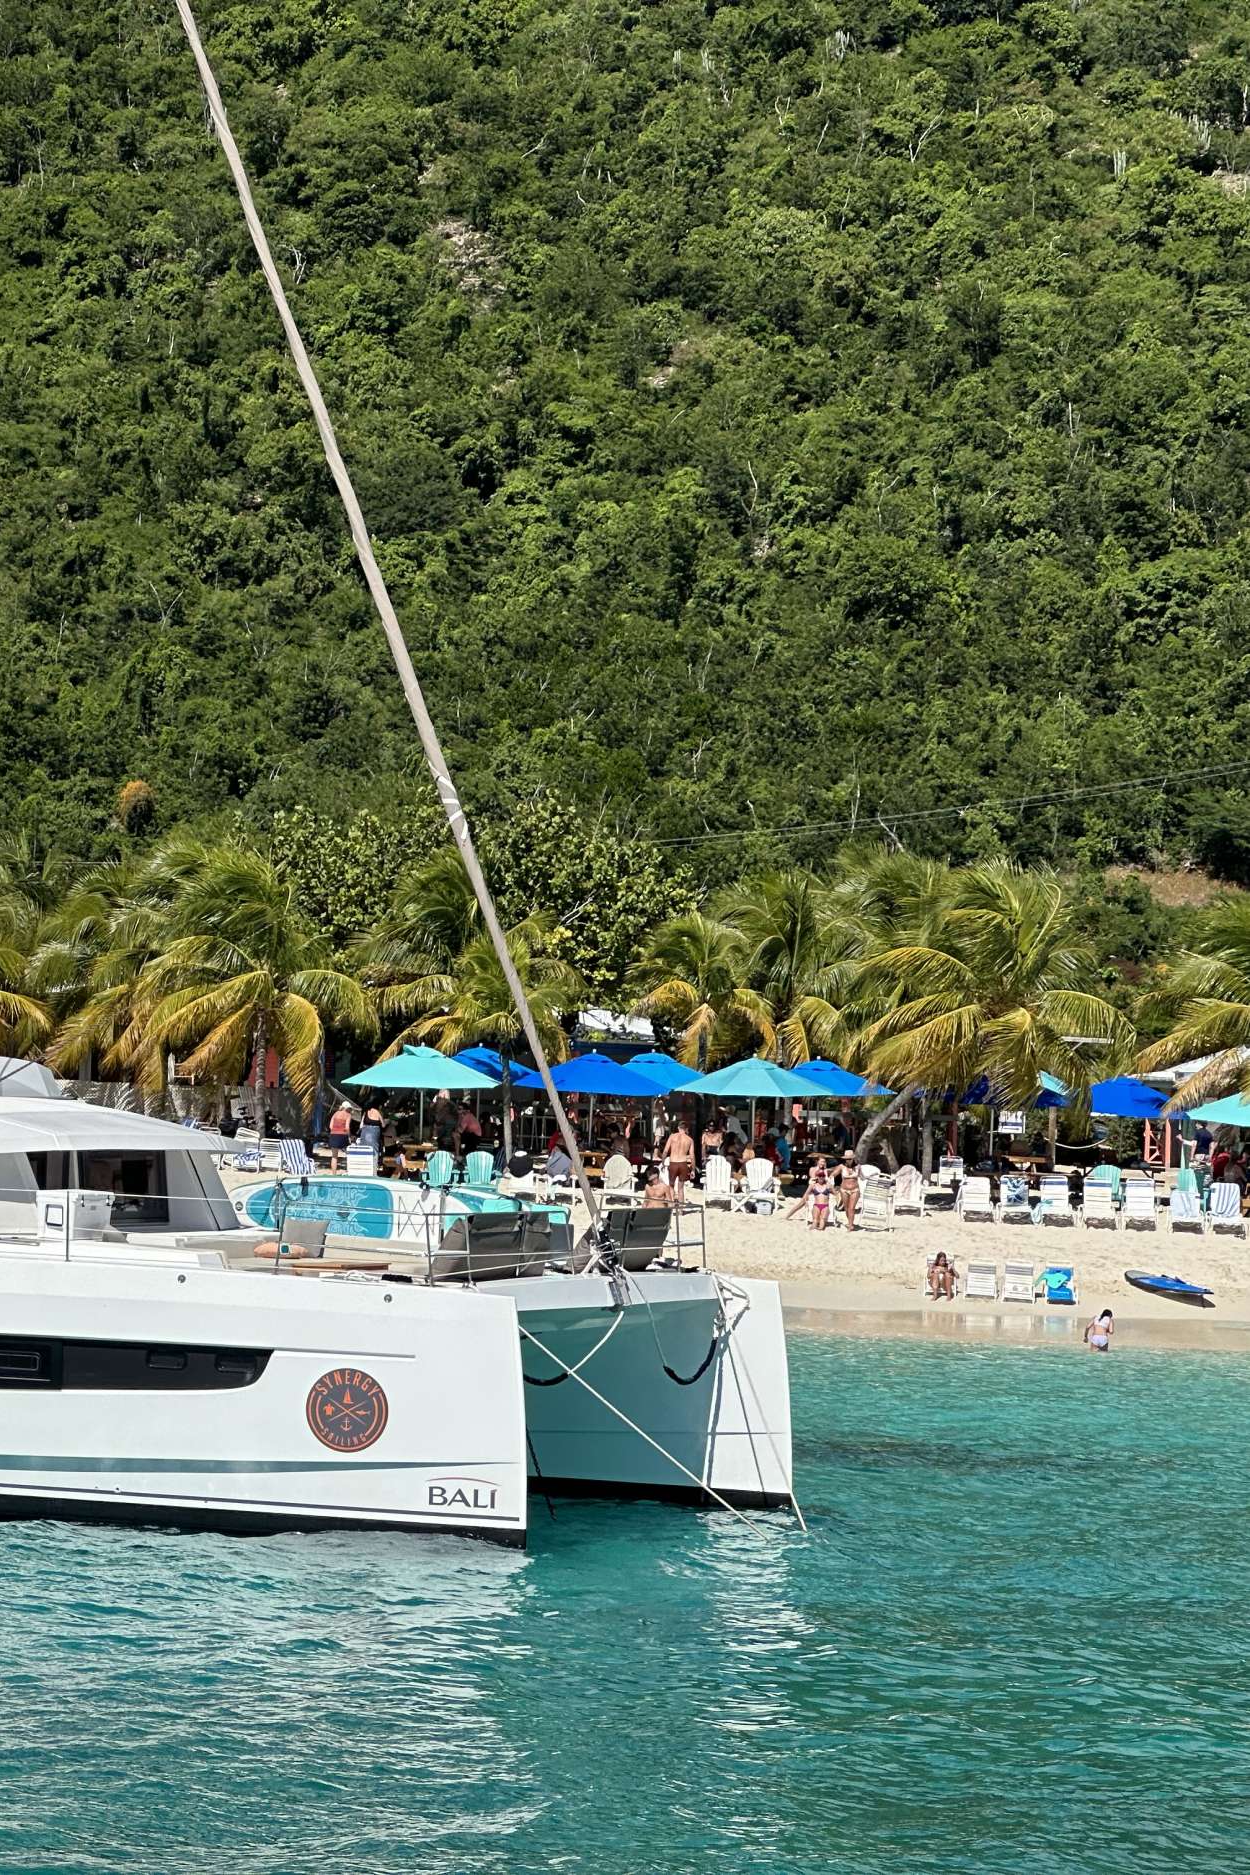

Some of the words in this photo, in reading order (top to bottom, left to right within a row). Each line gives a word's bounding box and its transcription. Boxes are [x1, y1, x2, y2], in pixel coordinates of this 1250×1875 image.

[315, 1369, 380, 1396] SYNERGY
[321, 1427, 367, 1446] SAILING
[428, 1486, 498, 1509] BALI
